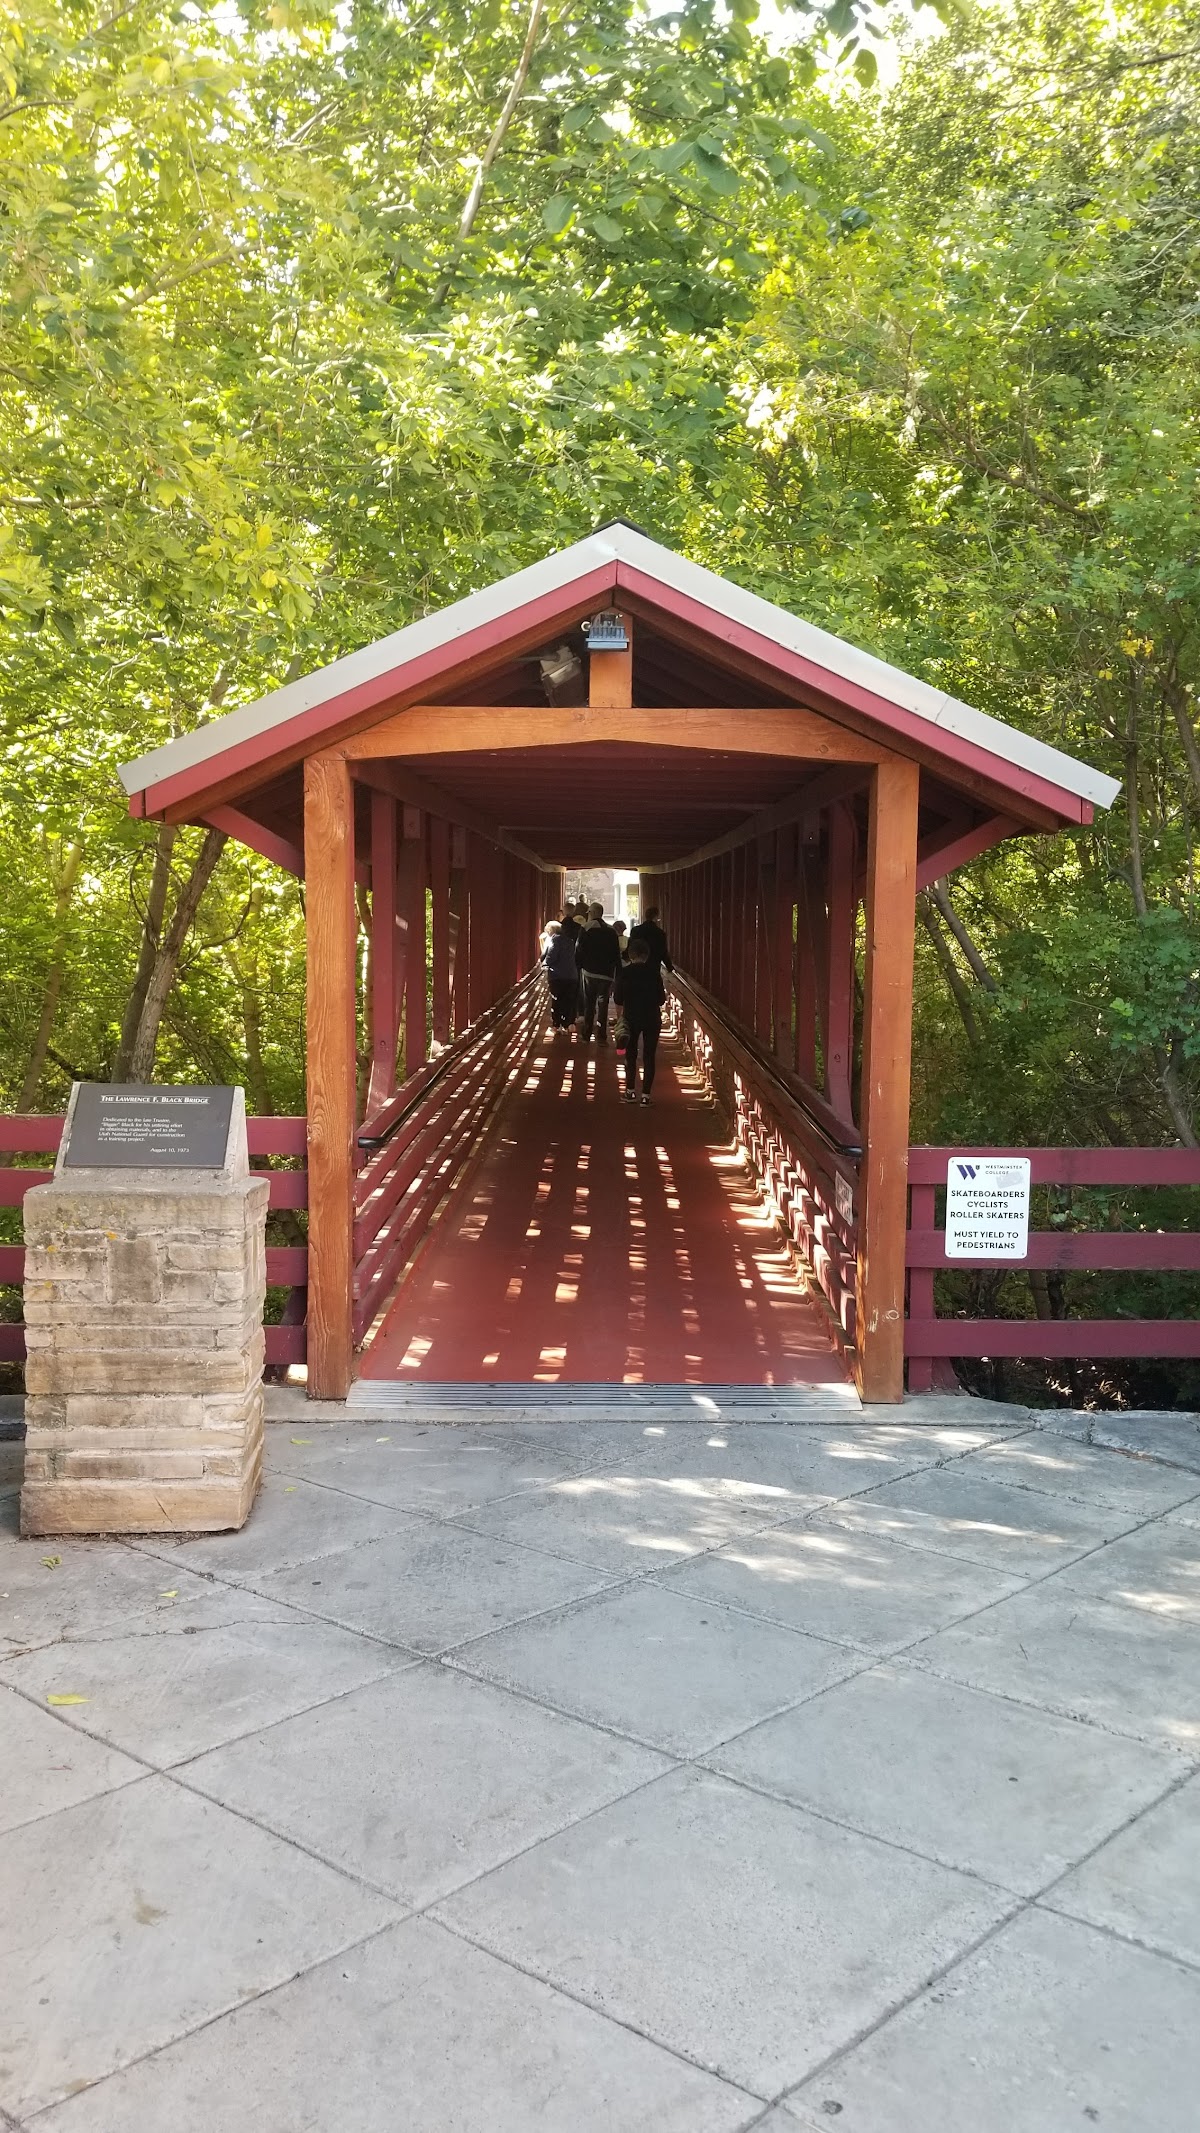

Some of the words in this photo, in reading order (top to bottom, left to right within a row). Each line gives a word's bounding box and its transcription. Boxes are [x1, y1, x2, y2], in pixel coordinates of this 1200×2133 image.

[951, 1190, 1025, 1198] SKATEBOARDERS
[950, 1211, 984, 1219] ROLLER
[1006, 1231, 1019, 1239] TO
[956, 1241, 1016, 1249] PEDESTRIANS
